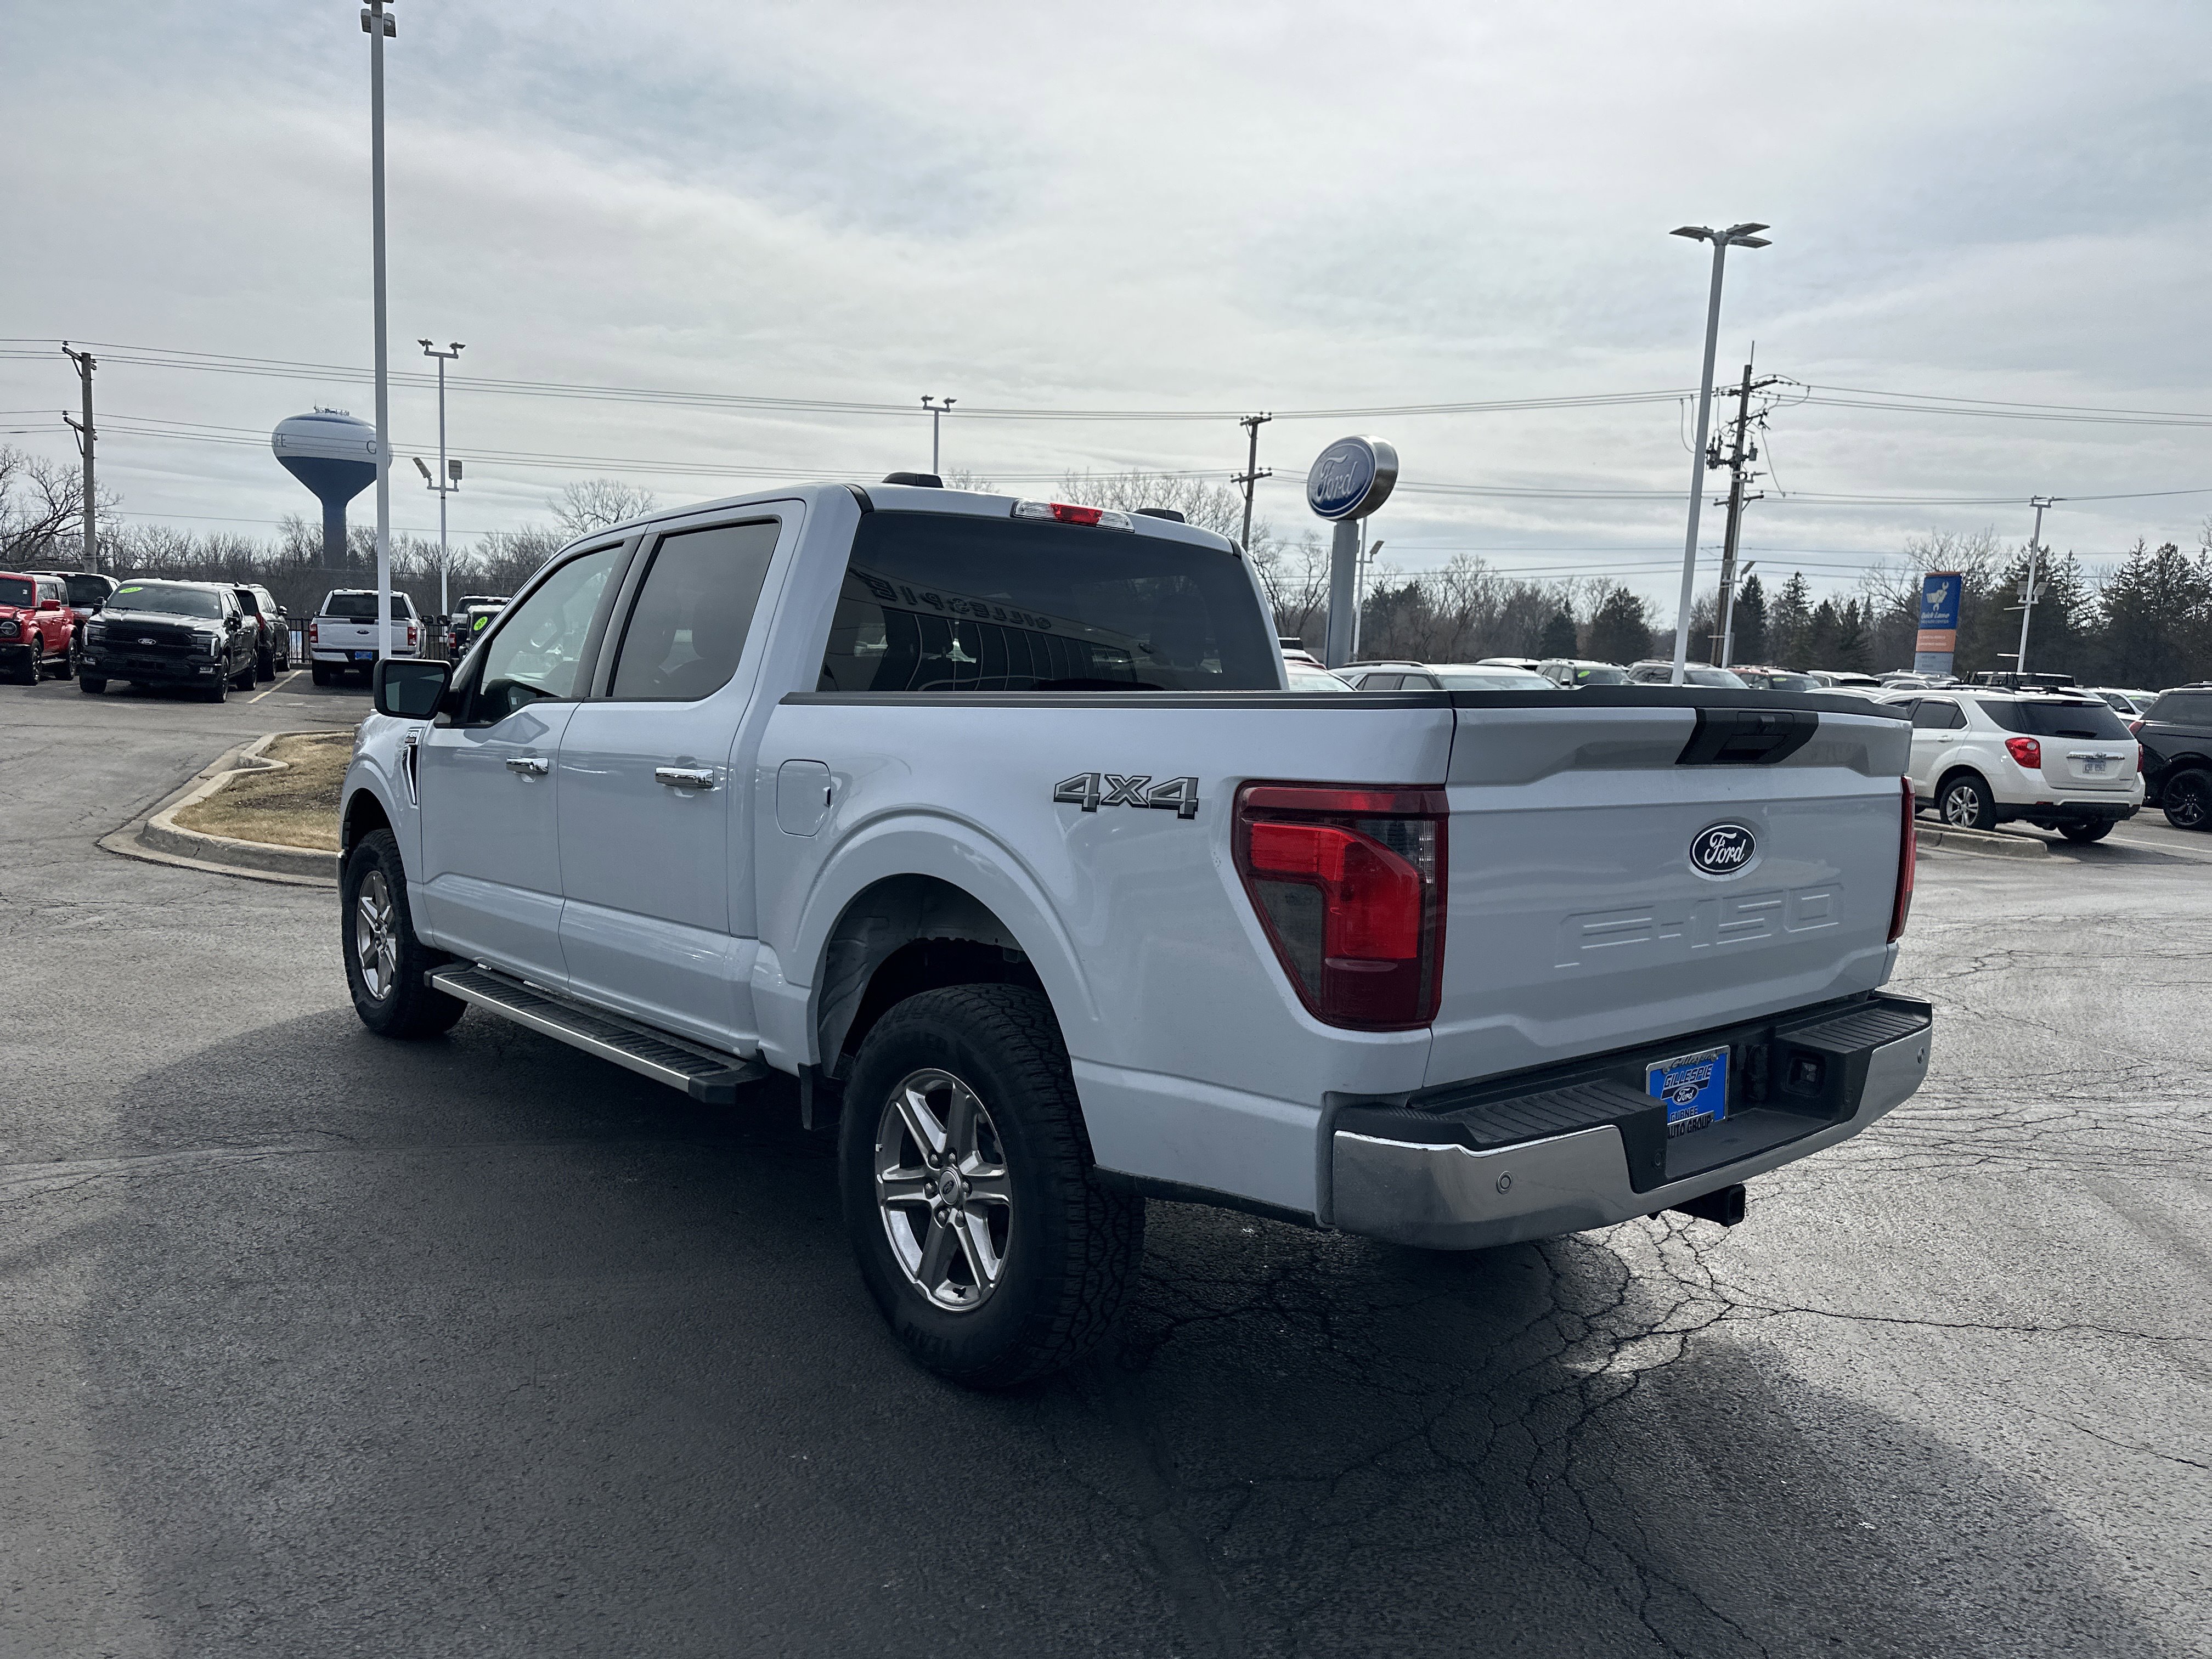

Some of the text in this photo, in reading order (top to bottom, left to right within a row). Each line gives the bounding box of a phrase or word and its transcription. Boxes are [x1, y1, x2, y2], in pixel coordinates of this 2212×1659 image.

[1316, 454, 1358, 502] Ford
[476, 618, 485, 629] 2020
[1704, 832, 1746, 865] Ford
[1555, 882, 1844, 968] F-150
[1664, 1063, 1713, 1088] GILLESPIE
[1677, 1088, 1693, 1102] Ford
[1670, 1105, 1699, 1122] GURNEE
[1687, 1114, 1711, 1133] GROUP
